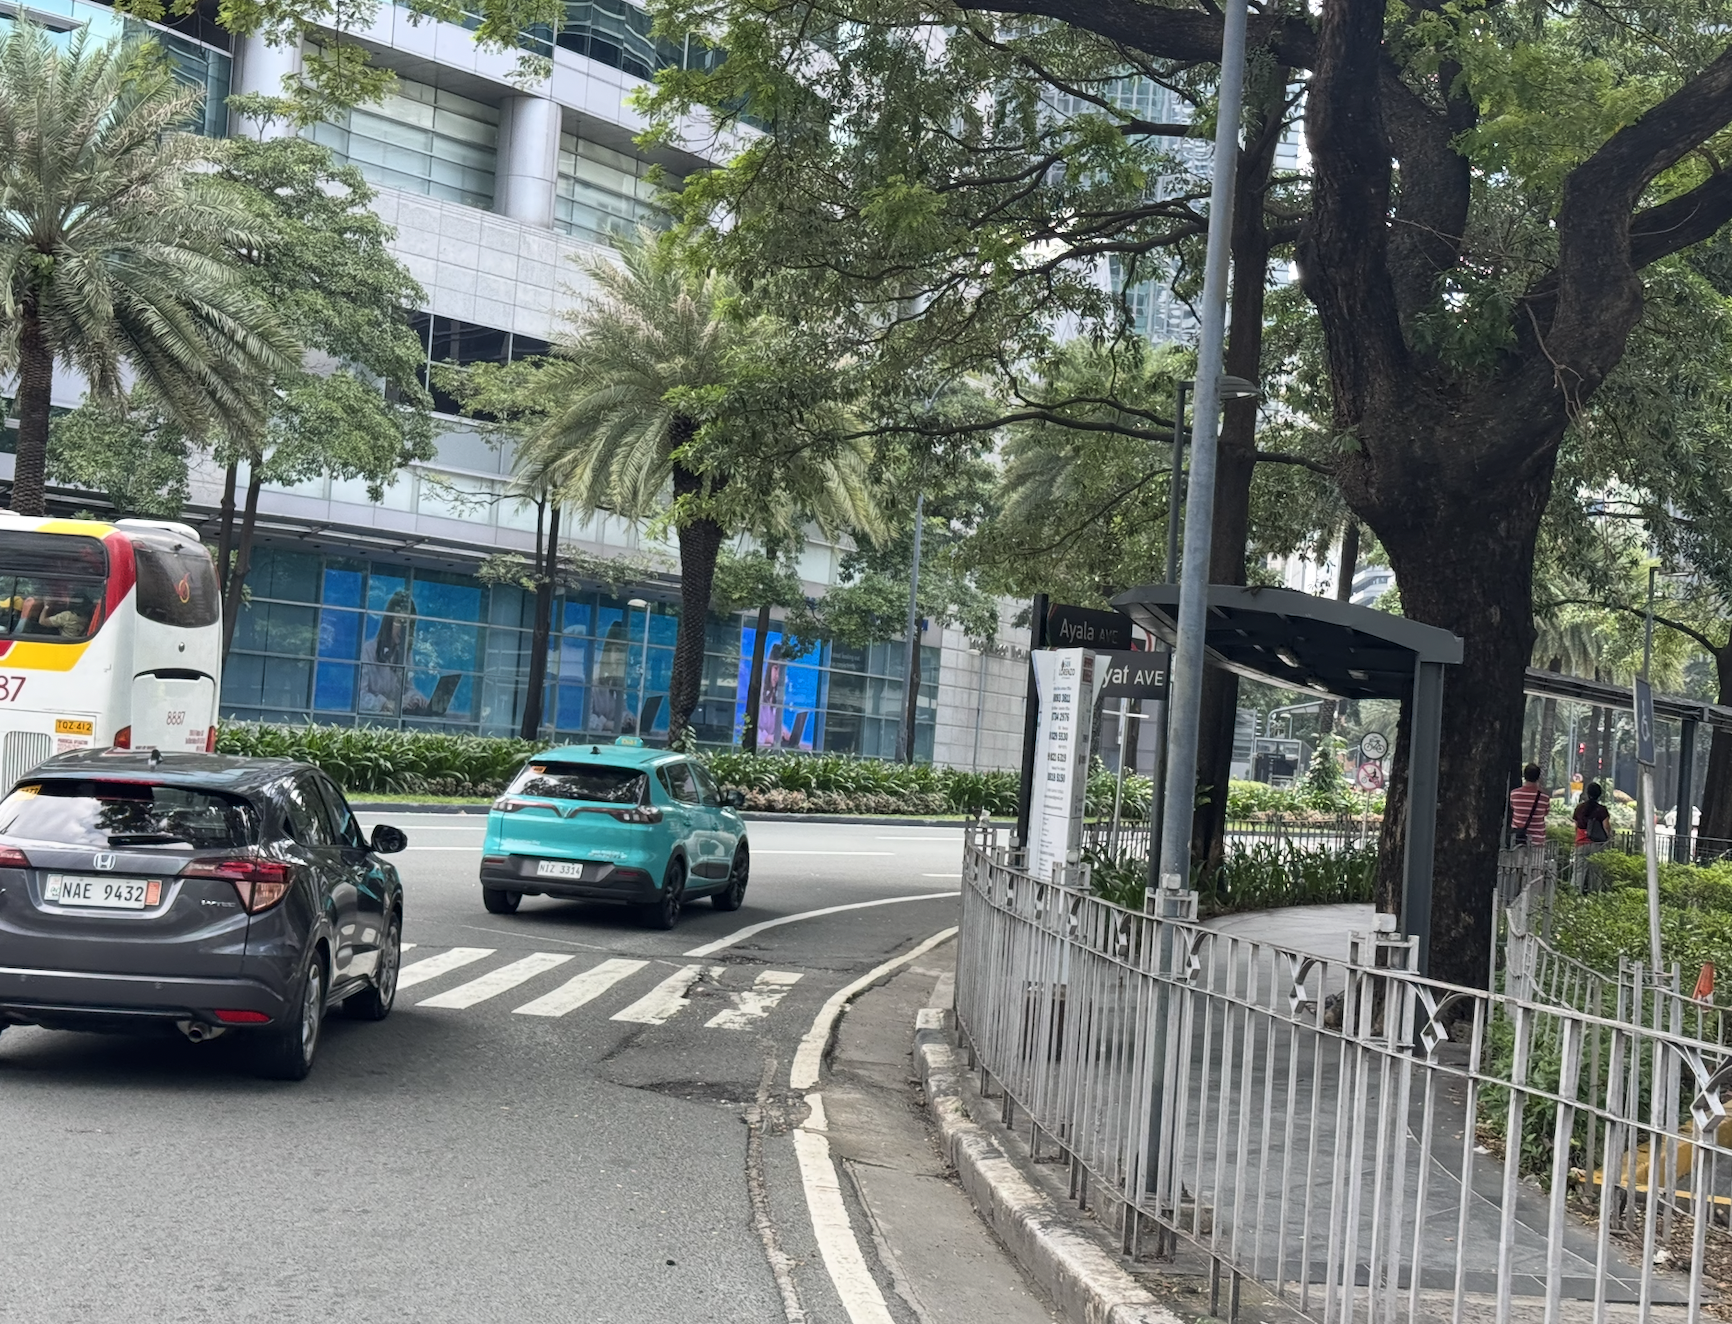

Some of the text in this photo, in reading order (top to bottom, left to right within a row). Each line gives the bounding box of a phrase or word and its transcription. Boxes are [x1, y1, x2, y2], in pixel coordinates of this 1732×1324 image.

[1060, 618, 1119, 644] Ayala AVE
[1102, 665, 1130, 688] yat
[1133, 669, 1164, 687] AVE
[166, 711, 186, 726] 8887
[539, 861, 581, 875] NIZ 3314
[62, 881, 92, 900] NAE
[104, 884, 144, 902] 9432
